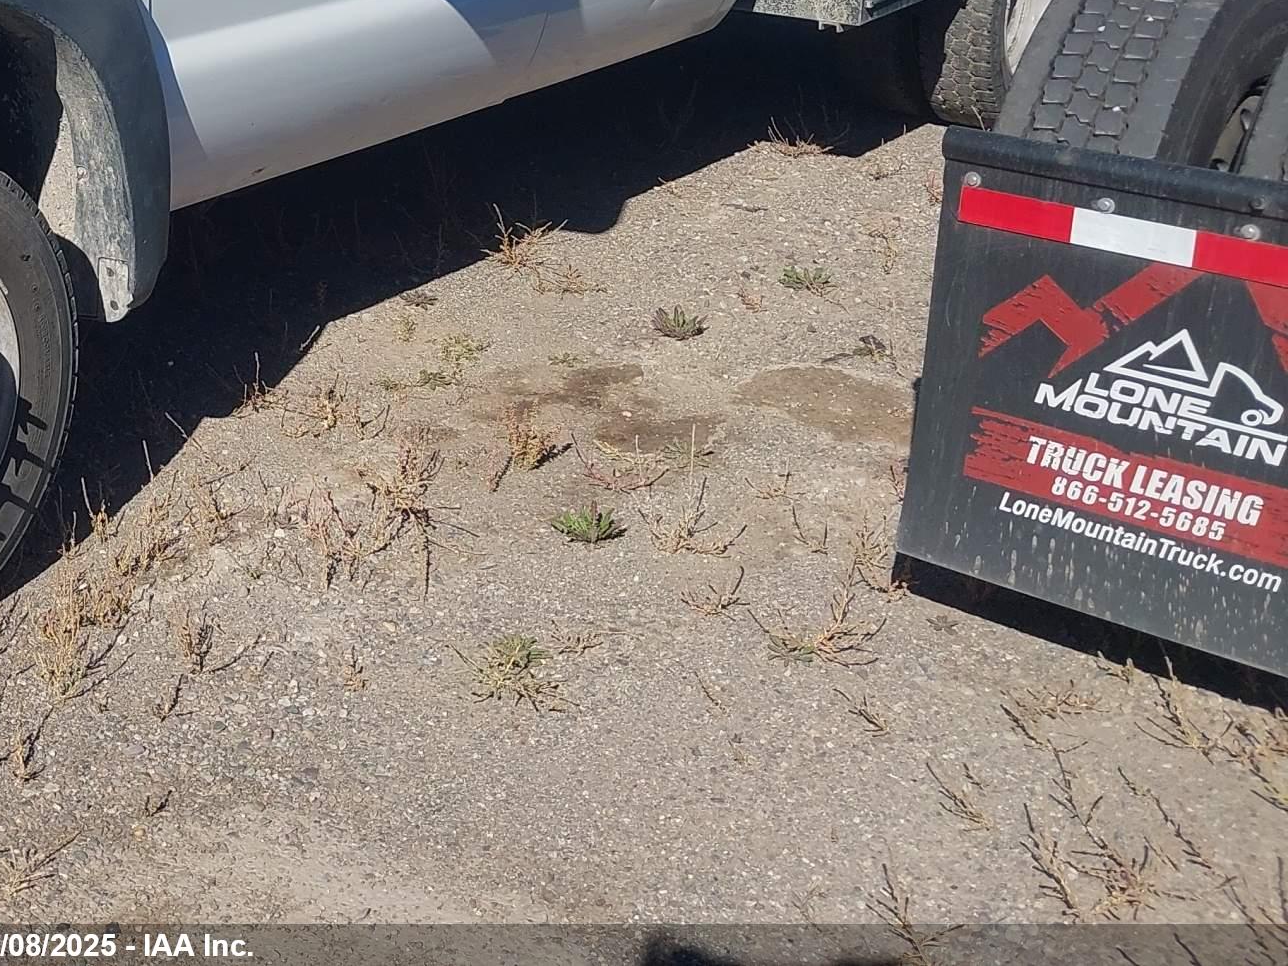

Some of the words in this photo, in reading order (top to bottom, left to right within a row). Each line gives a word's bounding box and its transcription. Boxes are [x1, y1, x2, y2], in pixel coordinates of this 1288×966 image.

[1034, 378, 1288, 466] MOUNTAIN
[1084, 372, 1212, 416] LONE
[1026, 435, 1130, 490] TRUCK
[1129, 464, 1265, 526] LEASING
[1051, 476, 1227, 542] 866-512-5685
[999, 491, 1283, 593] LoneMountainTruck.com
